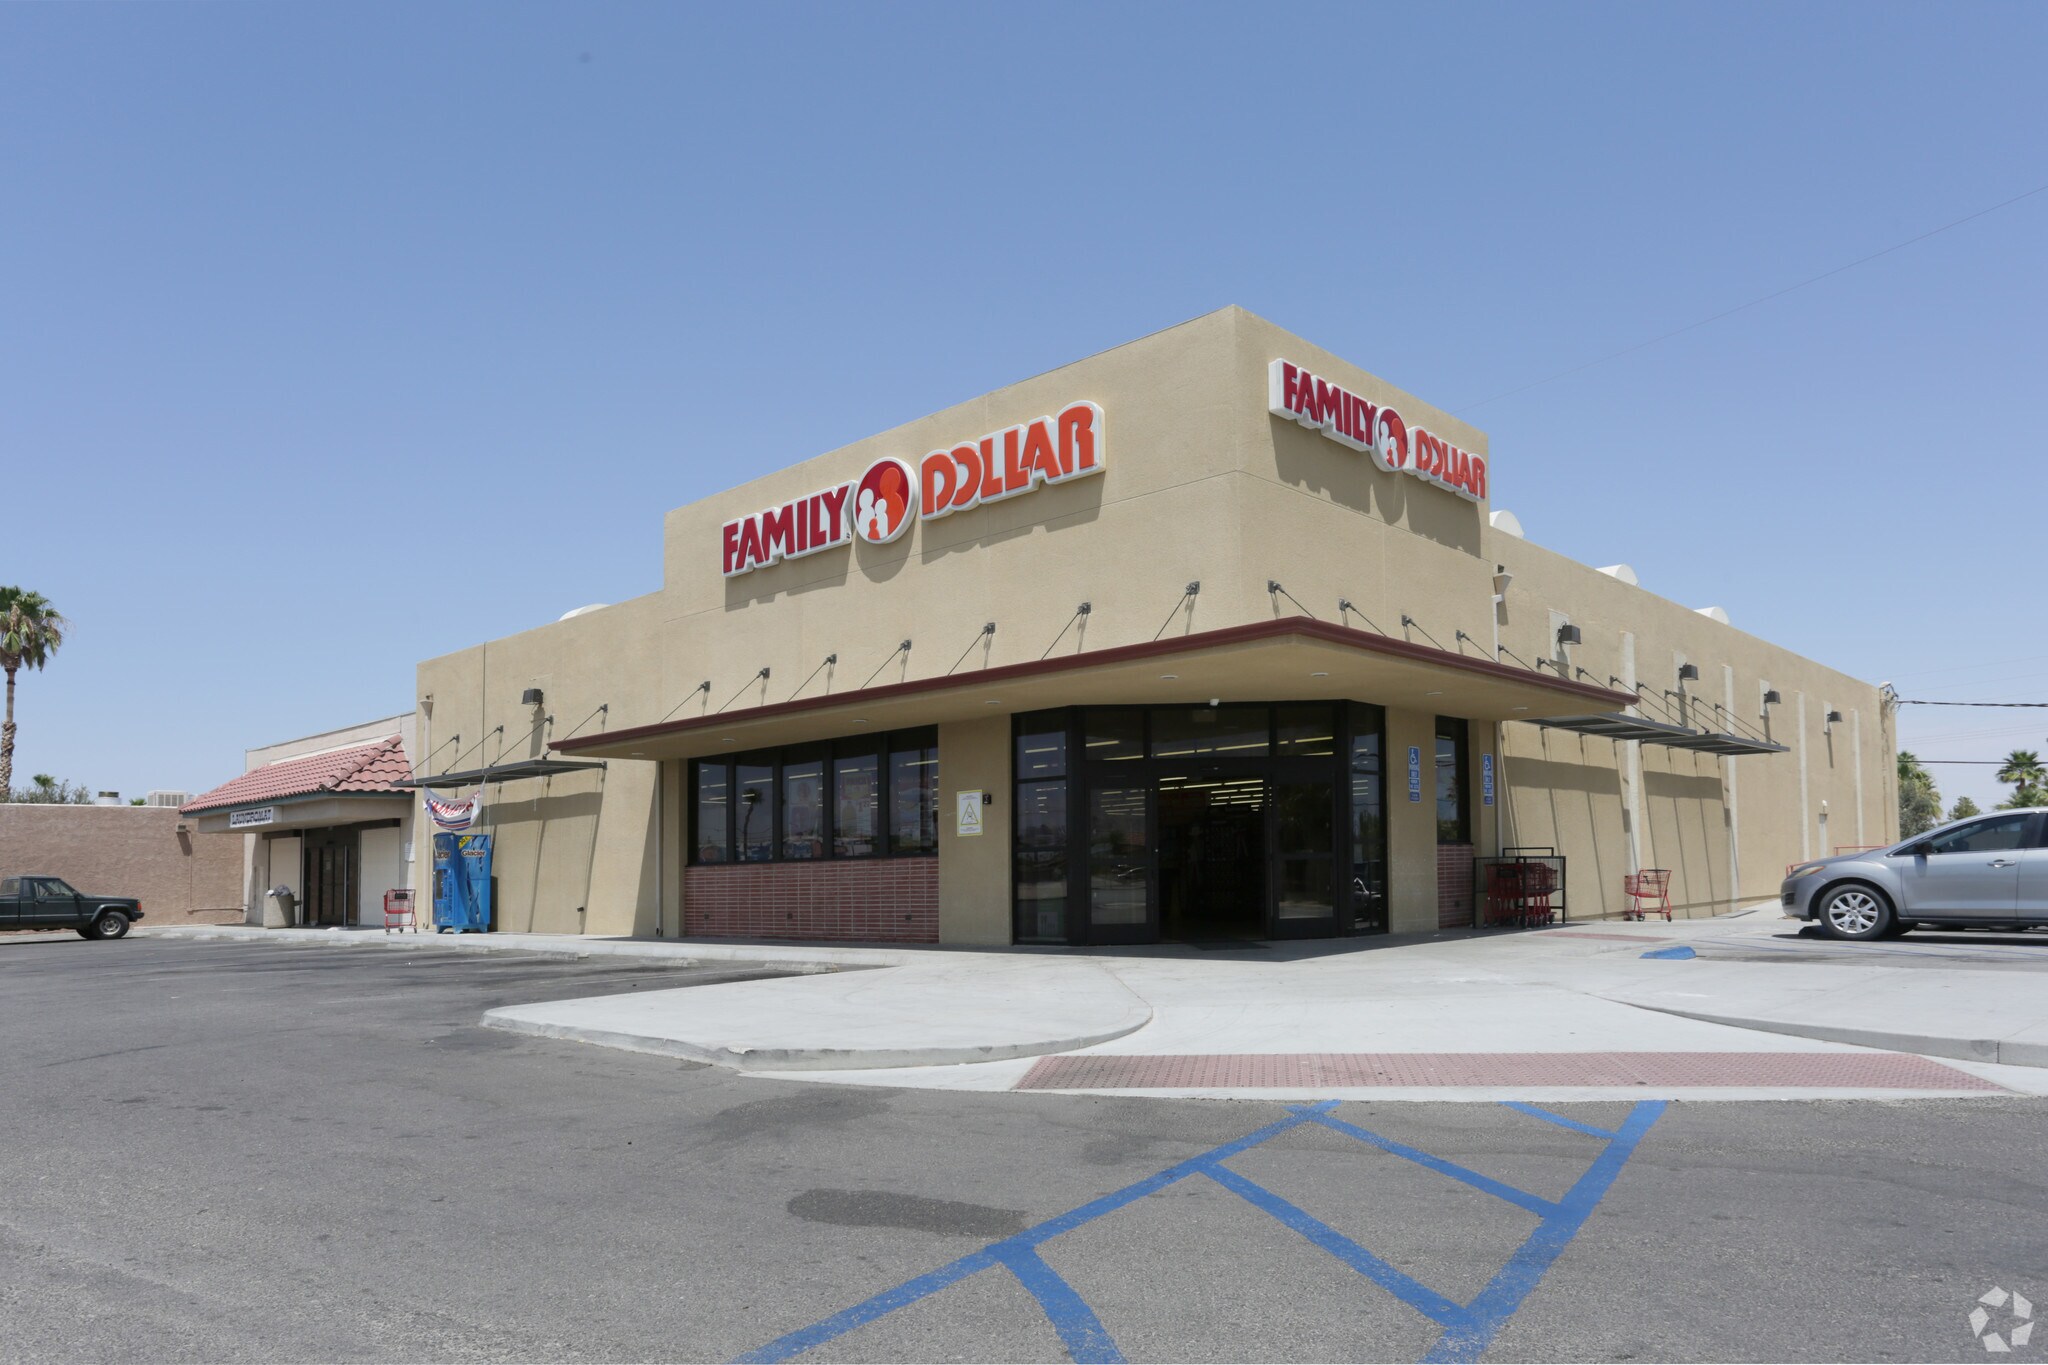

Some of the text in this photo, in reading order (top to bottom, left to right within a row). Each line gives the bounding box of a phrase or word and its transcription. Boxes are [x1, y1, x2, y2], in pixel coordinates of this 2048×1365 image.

[722, 404, 1095, 575] FAMILY DOLLAR
[1282, 361, 1486, 499] FAMILY DOLLAR
[231, 809, 272, 825] LAUNDROMAT
